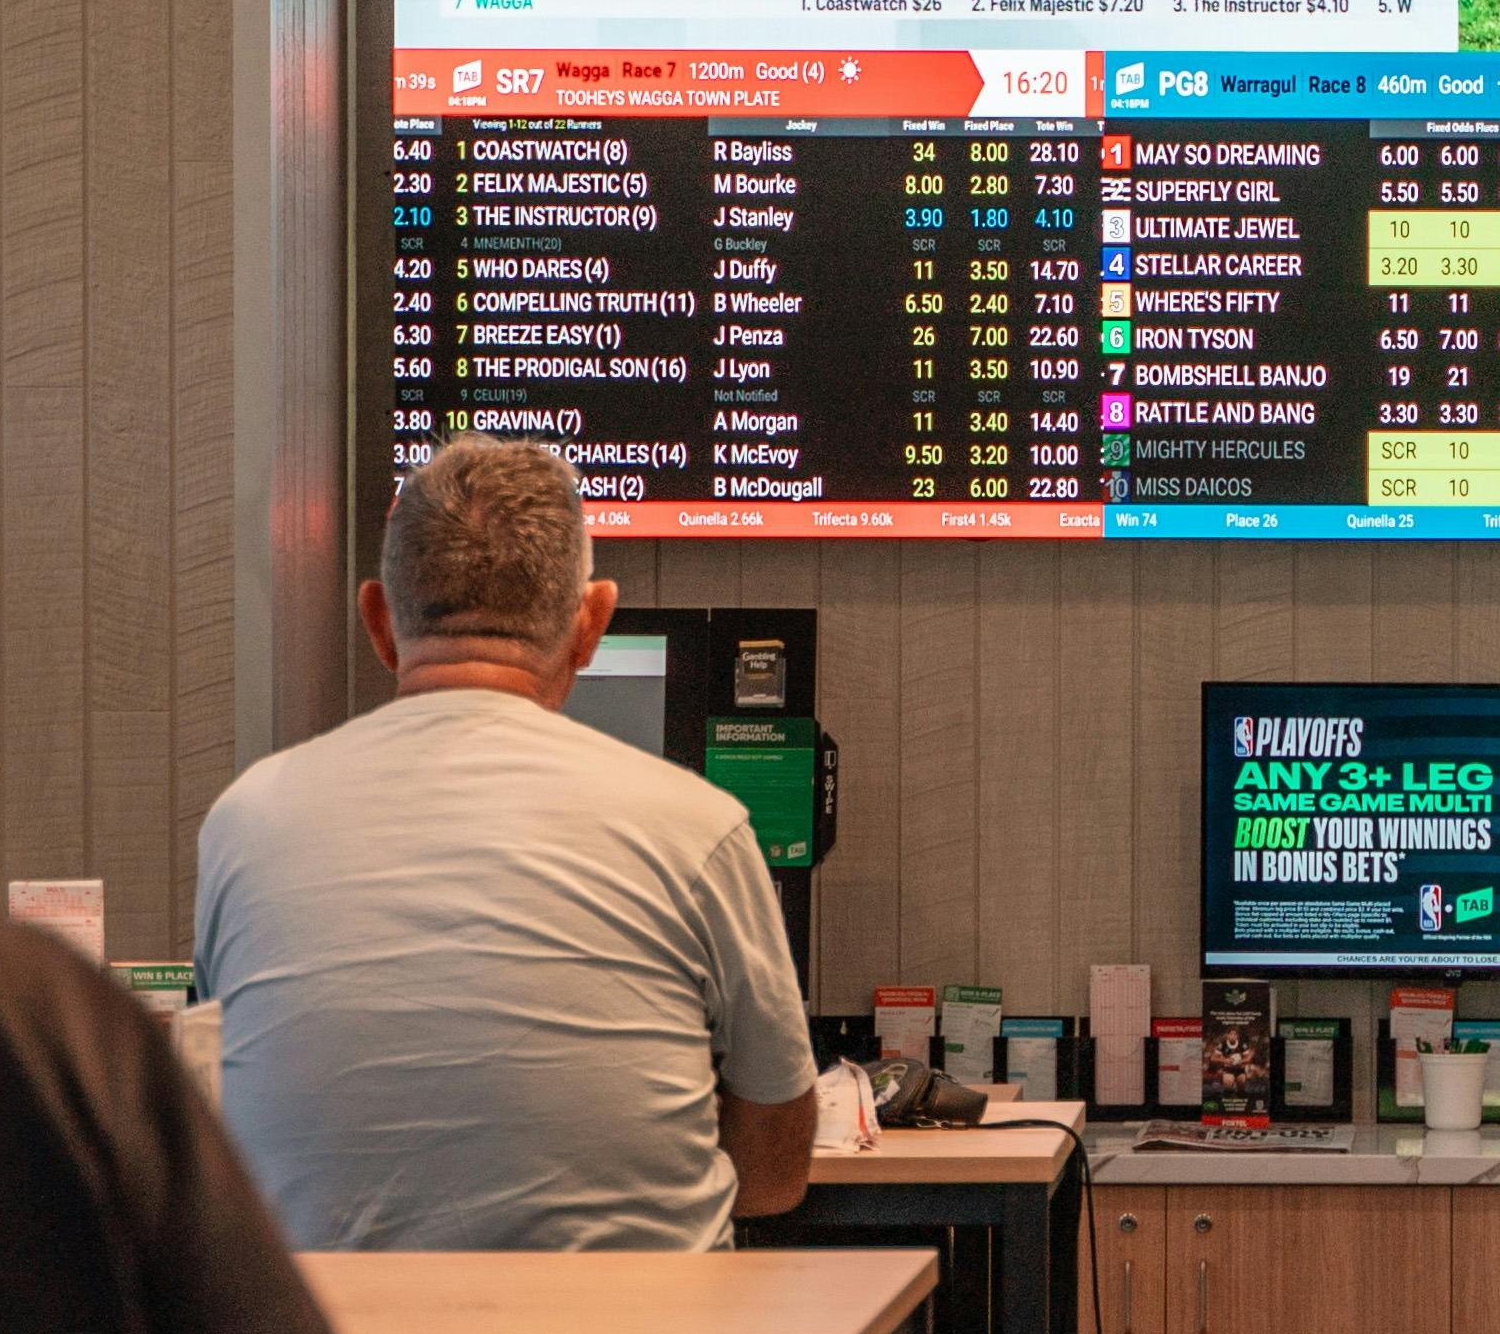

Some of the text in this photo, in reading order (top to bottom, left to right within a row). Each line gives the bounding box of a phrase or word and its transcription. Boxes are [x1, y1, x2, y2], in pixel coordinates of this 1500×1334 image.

[496, 61, 824, 94] SR7 1200m Good (4)
[1002, 71, 1068, 96] 16:20
[1160, 71, 1296, 97] PG8 Warragul
[474, 140, 627, 164] COASTWATCH (8)
[474, 172, 647, 197] FELIX MAJESTIC (5)
[474, 205, 656, 230] THE INSTRUCTOR (9)
[716, 725, 773, 733] IMPORTANT
[716, 733, 785, 741] INFORMATION
[1256, 718, 1363, 756] PLAYOFFS
[1234, 762, 1493, 791] ANY 3+ LEG
[1234, 793, 1491, 812] SAME GAME MULTI
[1234, 818, 1491, 849] BOOST YOUR WINNINGS
[1234, 851, 1257, 881] IN
[1263, 851, 1337, 882] BONUS
[1461, 898, 1488, 911] TAB
[133, 972, 154, 980] WIN
